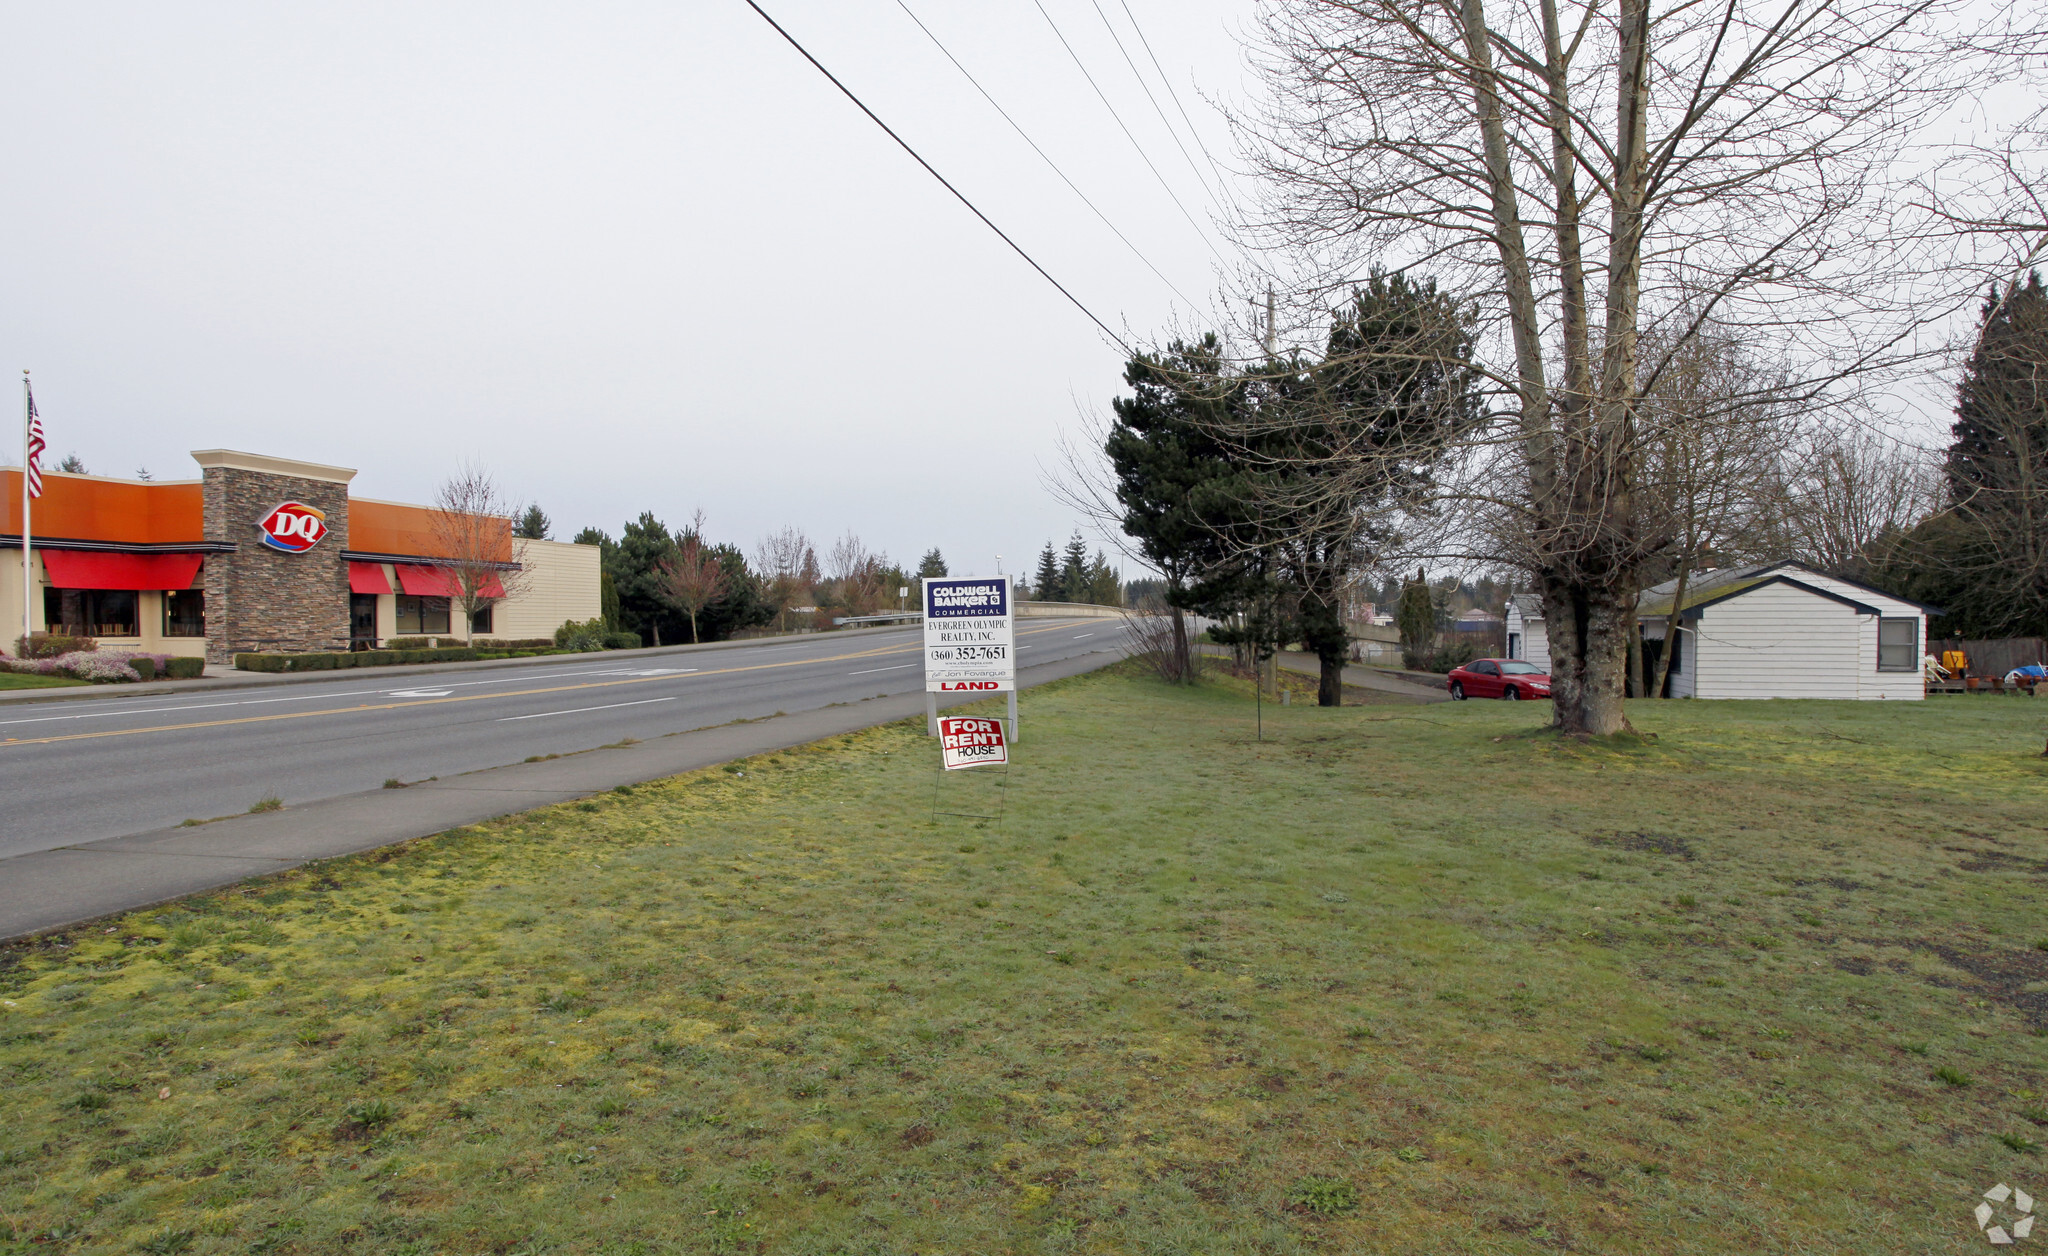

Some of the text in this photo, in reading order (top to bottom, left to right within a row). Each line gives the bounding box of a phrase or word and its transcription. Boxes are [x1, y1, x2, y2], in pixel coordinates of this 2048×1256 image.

[272, 512, 320, 543] DQ
[933, 585, 1000, 597] COLDWELL
[934, 596, 989, 607] BANKER
[928, 620, 1007, 631] EVERGREEN OLYMPIC
[941, 632, 996, 642] REALTY, INC.
[931, 647, 1006, 660] (360) 352-7651
[941, 681, 999, 691] LAND
[949, 720, 993, 734] FOR
[944, 733, 1000, 748] RENT
[957, 745, 996, 757] HOUSE
